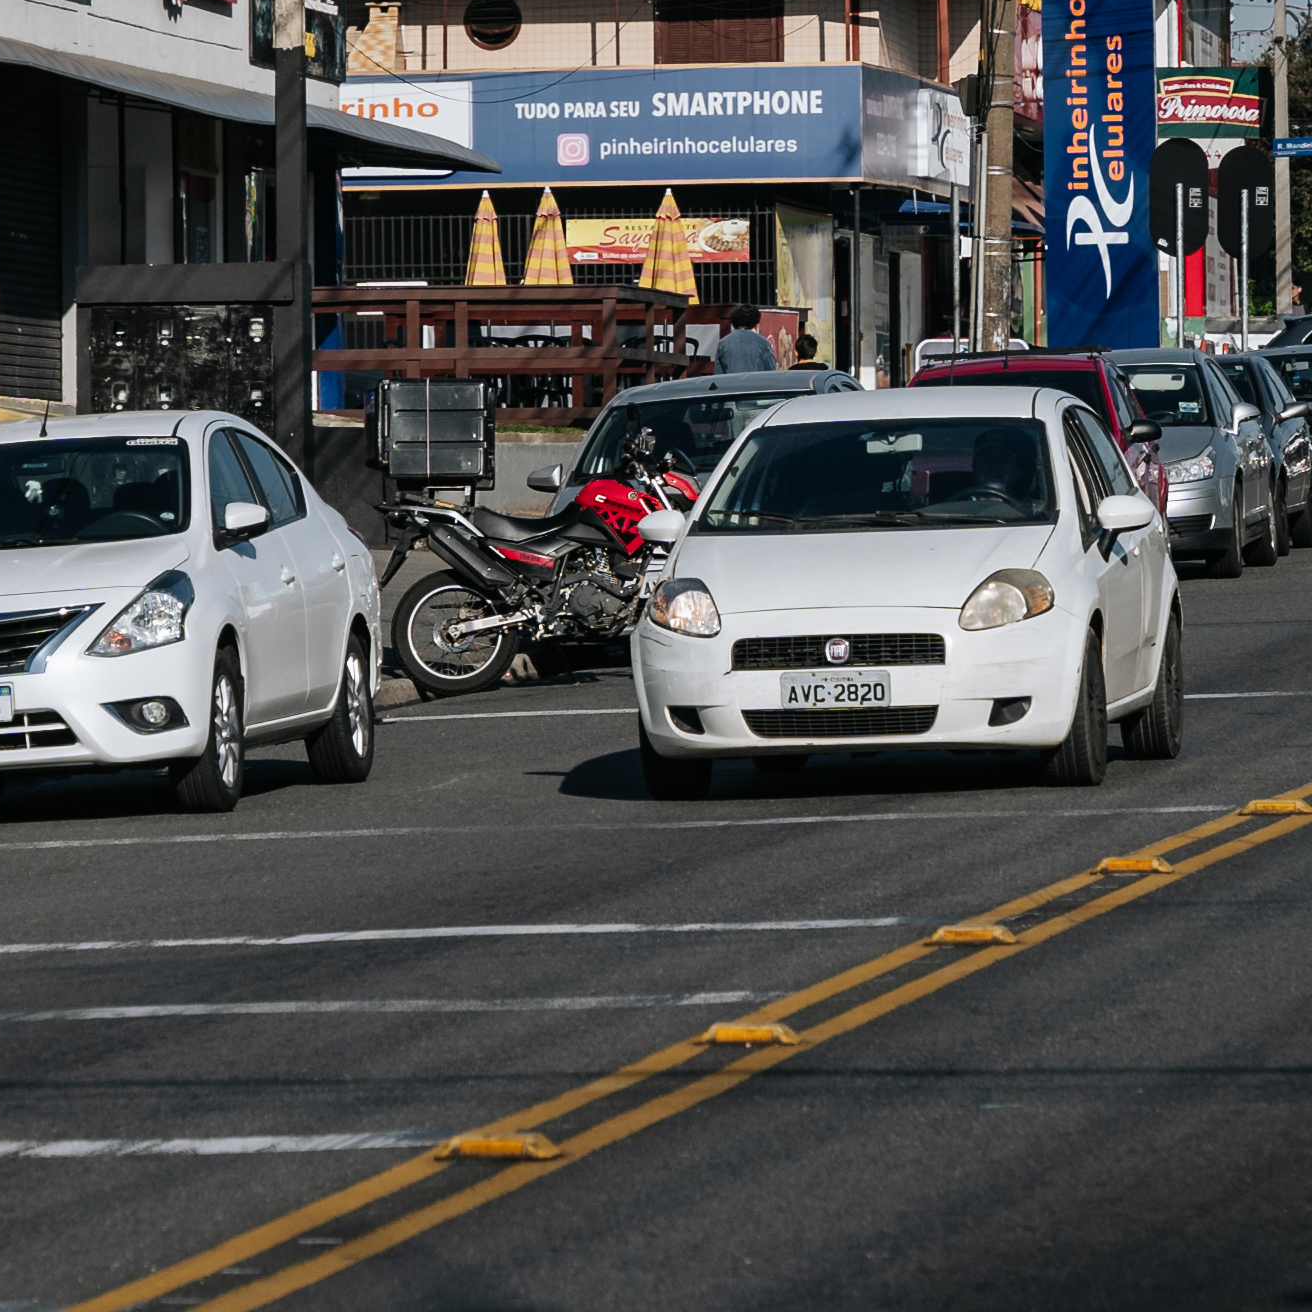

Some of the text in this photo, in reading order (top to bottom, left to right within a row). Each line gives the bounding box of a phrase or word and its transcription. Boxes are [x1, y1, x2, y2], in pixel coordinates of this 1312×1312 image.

[514, 90, 824, 120] TUDO PARA SEU SMARTPHONE
[1158, 95, 1260, 122] Primorosa
[599, 136, 799, 161] pinheirinhocelulares
[830, 646, 845, 657] FIAT
